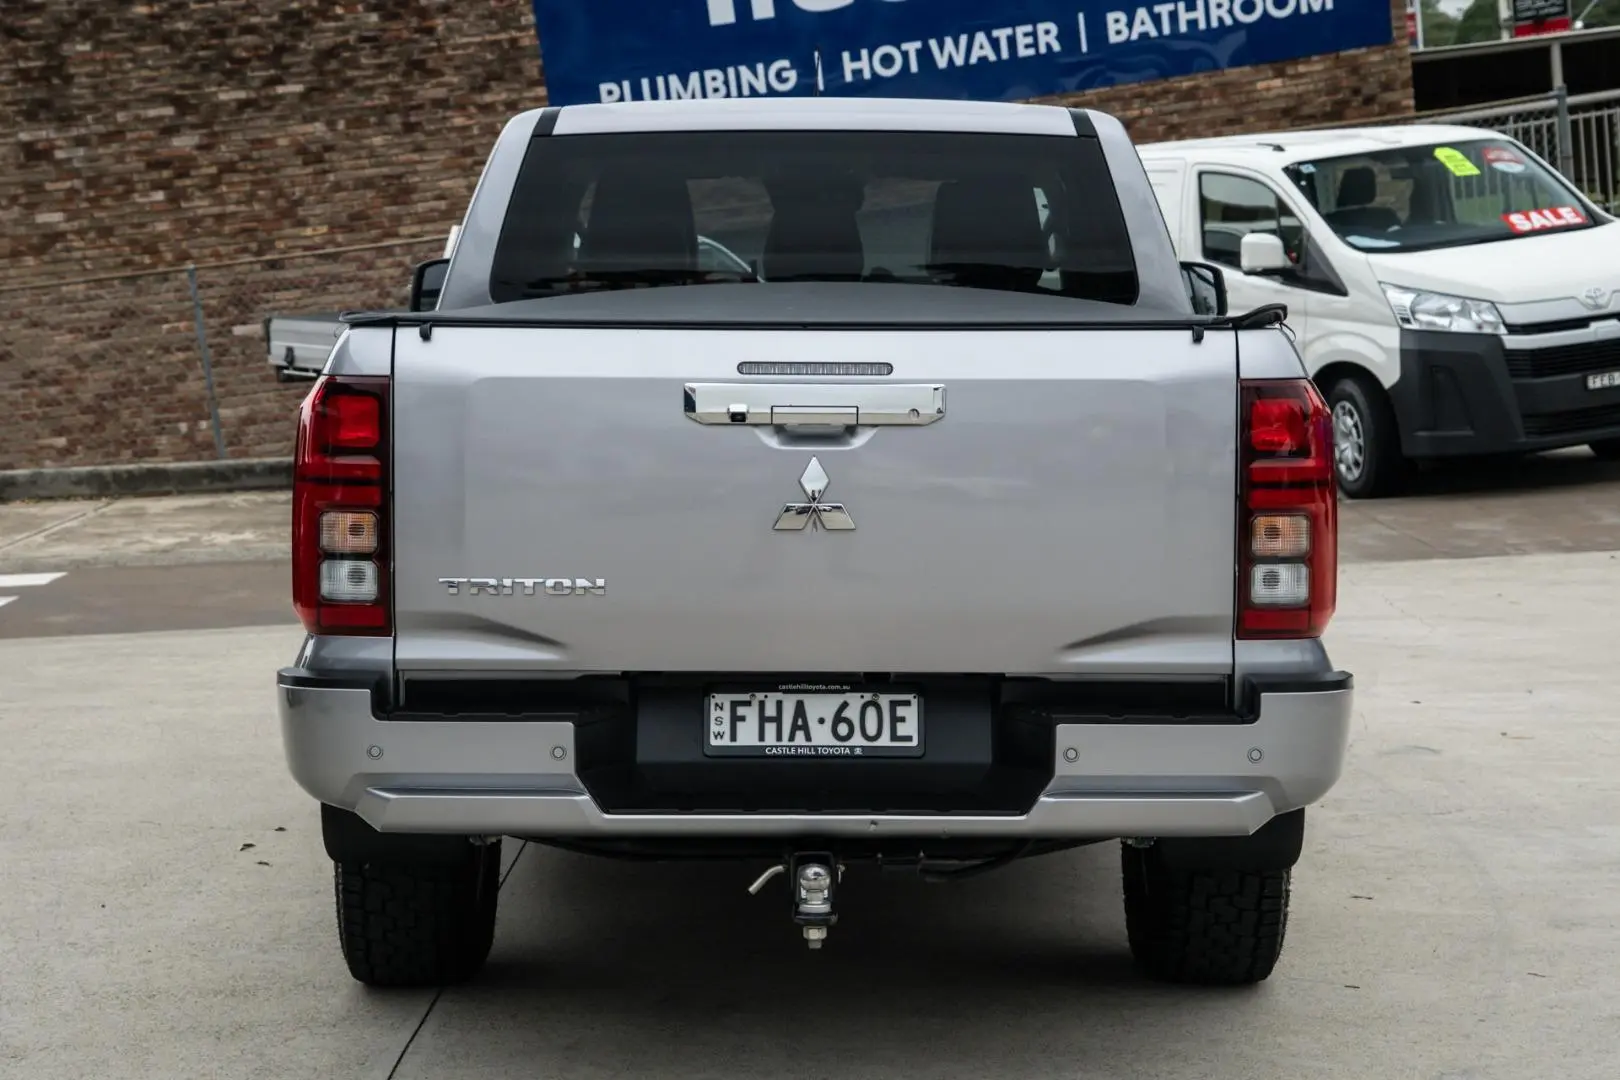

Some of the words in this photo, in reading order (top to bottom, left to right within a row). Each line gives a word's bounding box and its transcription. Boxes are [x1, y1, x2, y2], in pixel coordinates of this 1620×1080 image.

[599, 59, 797, 104] PLUMBING
[841, 40, 922, 83] HOT
[929, 21, 1061, 70] WATER
[1508, 206, 1582, 232] SALE
[438, 577, 605, 596] TRITON
[765, 746, 797, 755] CASTLE
[797, 746, 816, 755] HILL
[816, 746, 851, 755] TOYOTA
